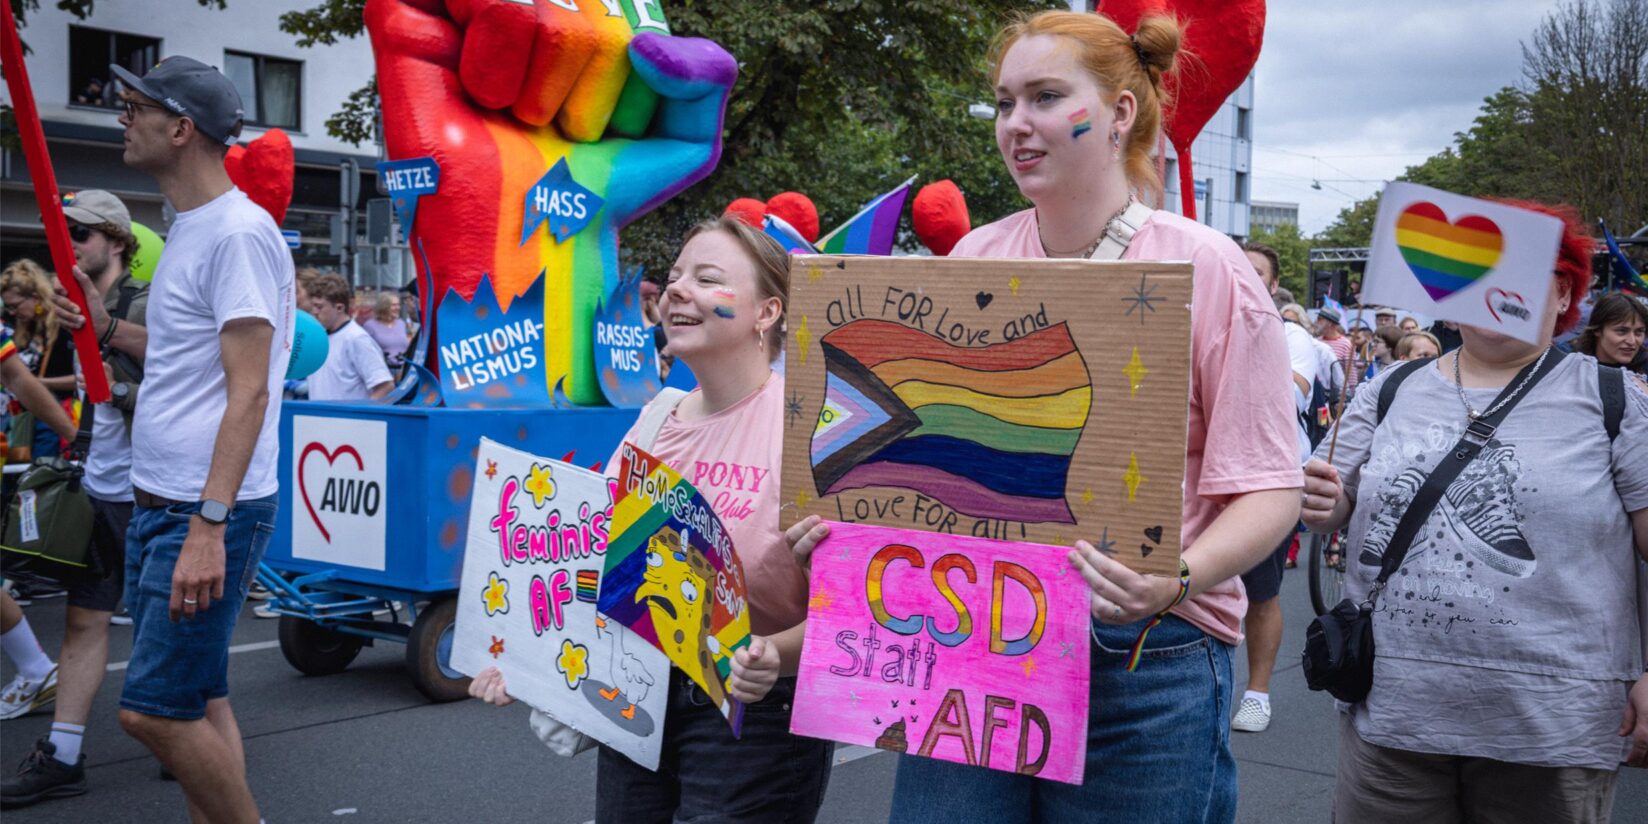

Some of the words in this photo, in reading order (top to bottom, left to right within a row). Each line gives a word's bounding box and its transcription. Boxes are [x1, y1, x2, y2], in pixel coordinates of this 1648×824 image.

[385, 164, 435, 191] HETZE
[534, 186, 587, 220] HASS
[597, 320, 650, 347] RASSIS-
[826, 285, 865, 327] all
[881, 285, 934, 331] FOR
[935, 307, 991, 346] Love
[1003, 302, 1050, 342] and
[441, 318, 544, 370] NATIONA-
[610, 350, 641, 372] MUS
[450, 346, 537, 391] LISMUS
[692, 460, 769, 493] PONY
[320, 477, 381, 517] AWO
[711, 490, 756, 521] Club
[836, 495, 904, 524] Love
[912, 494, 958, 534] FOR
[529, 568, 574, 637] AF
[865, 543, 1048, 656] CSD
[916, 688, 1052, 777] AFD
